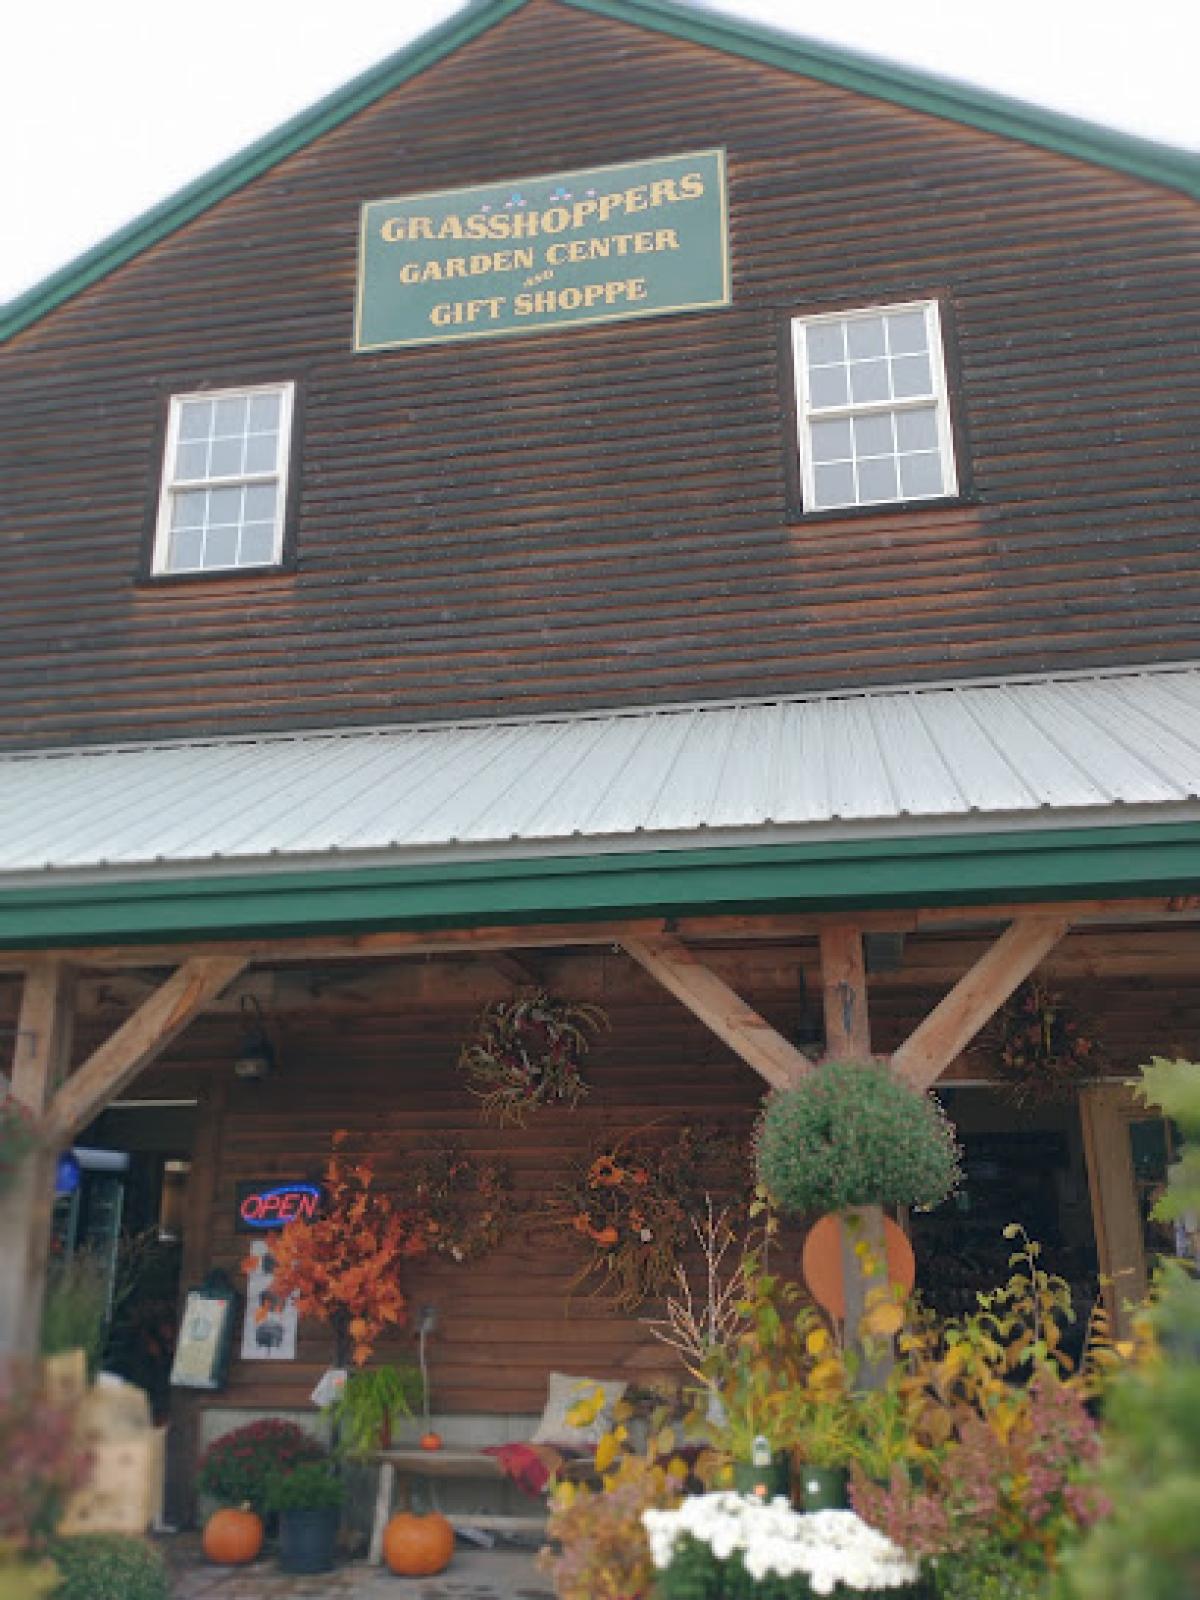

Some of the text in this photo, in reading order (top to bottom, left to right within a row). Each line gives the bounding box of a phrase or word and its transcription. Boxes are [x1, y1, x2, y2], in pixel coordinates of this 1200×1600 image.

[380, 173, 704, 242] GRASSHOPPERS
[400, 230, 680, 284] GARDEN CENTER
[429, 278, 647, 327] GIFT SHOPPE
[240, 1193, 318, 1218] OPEN
